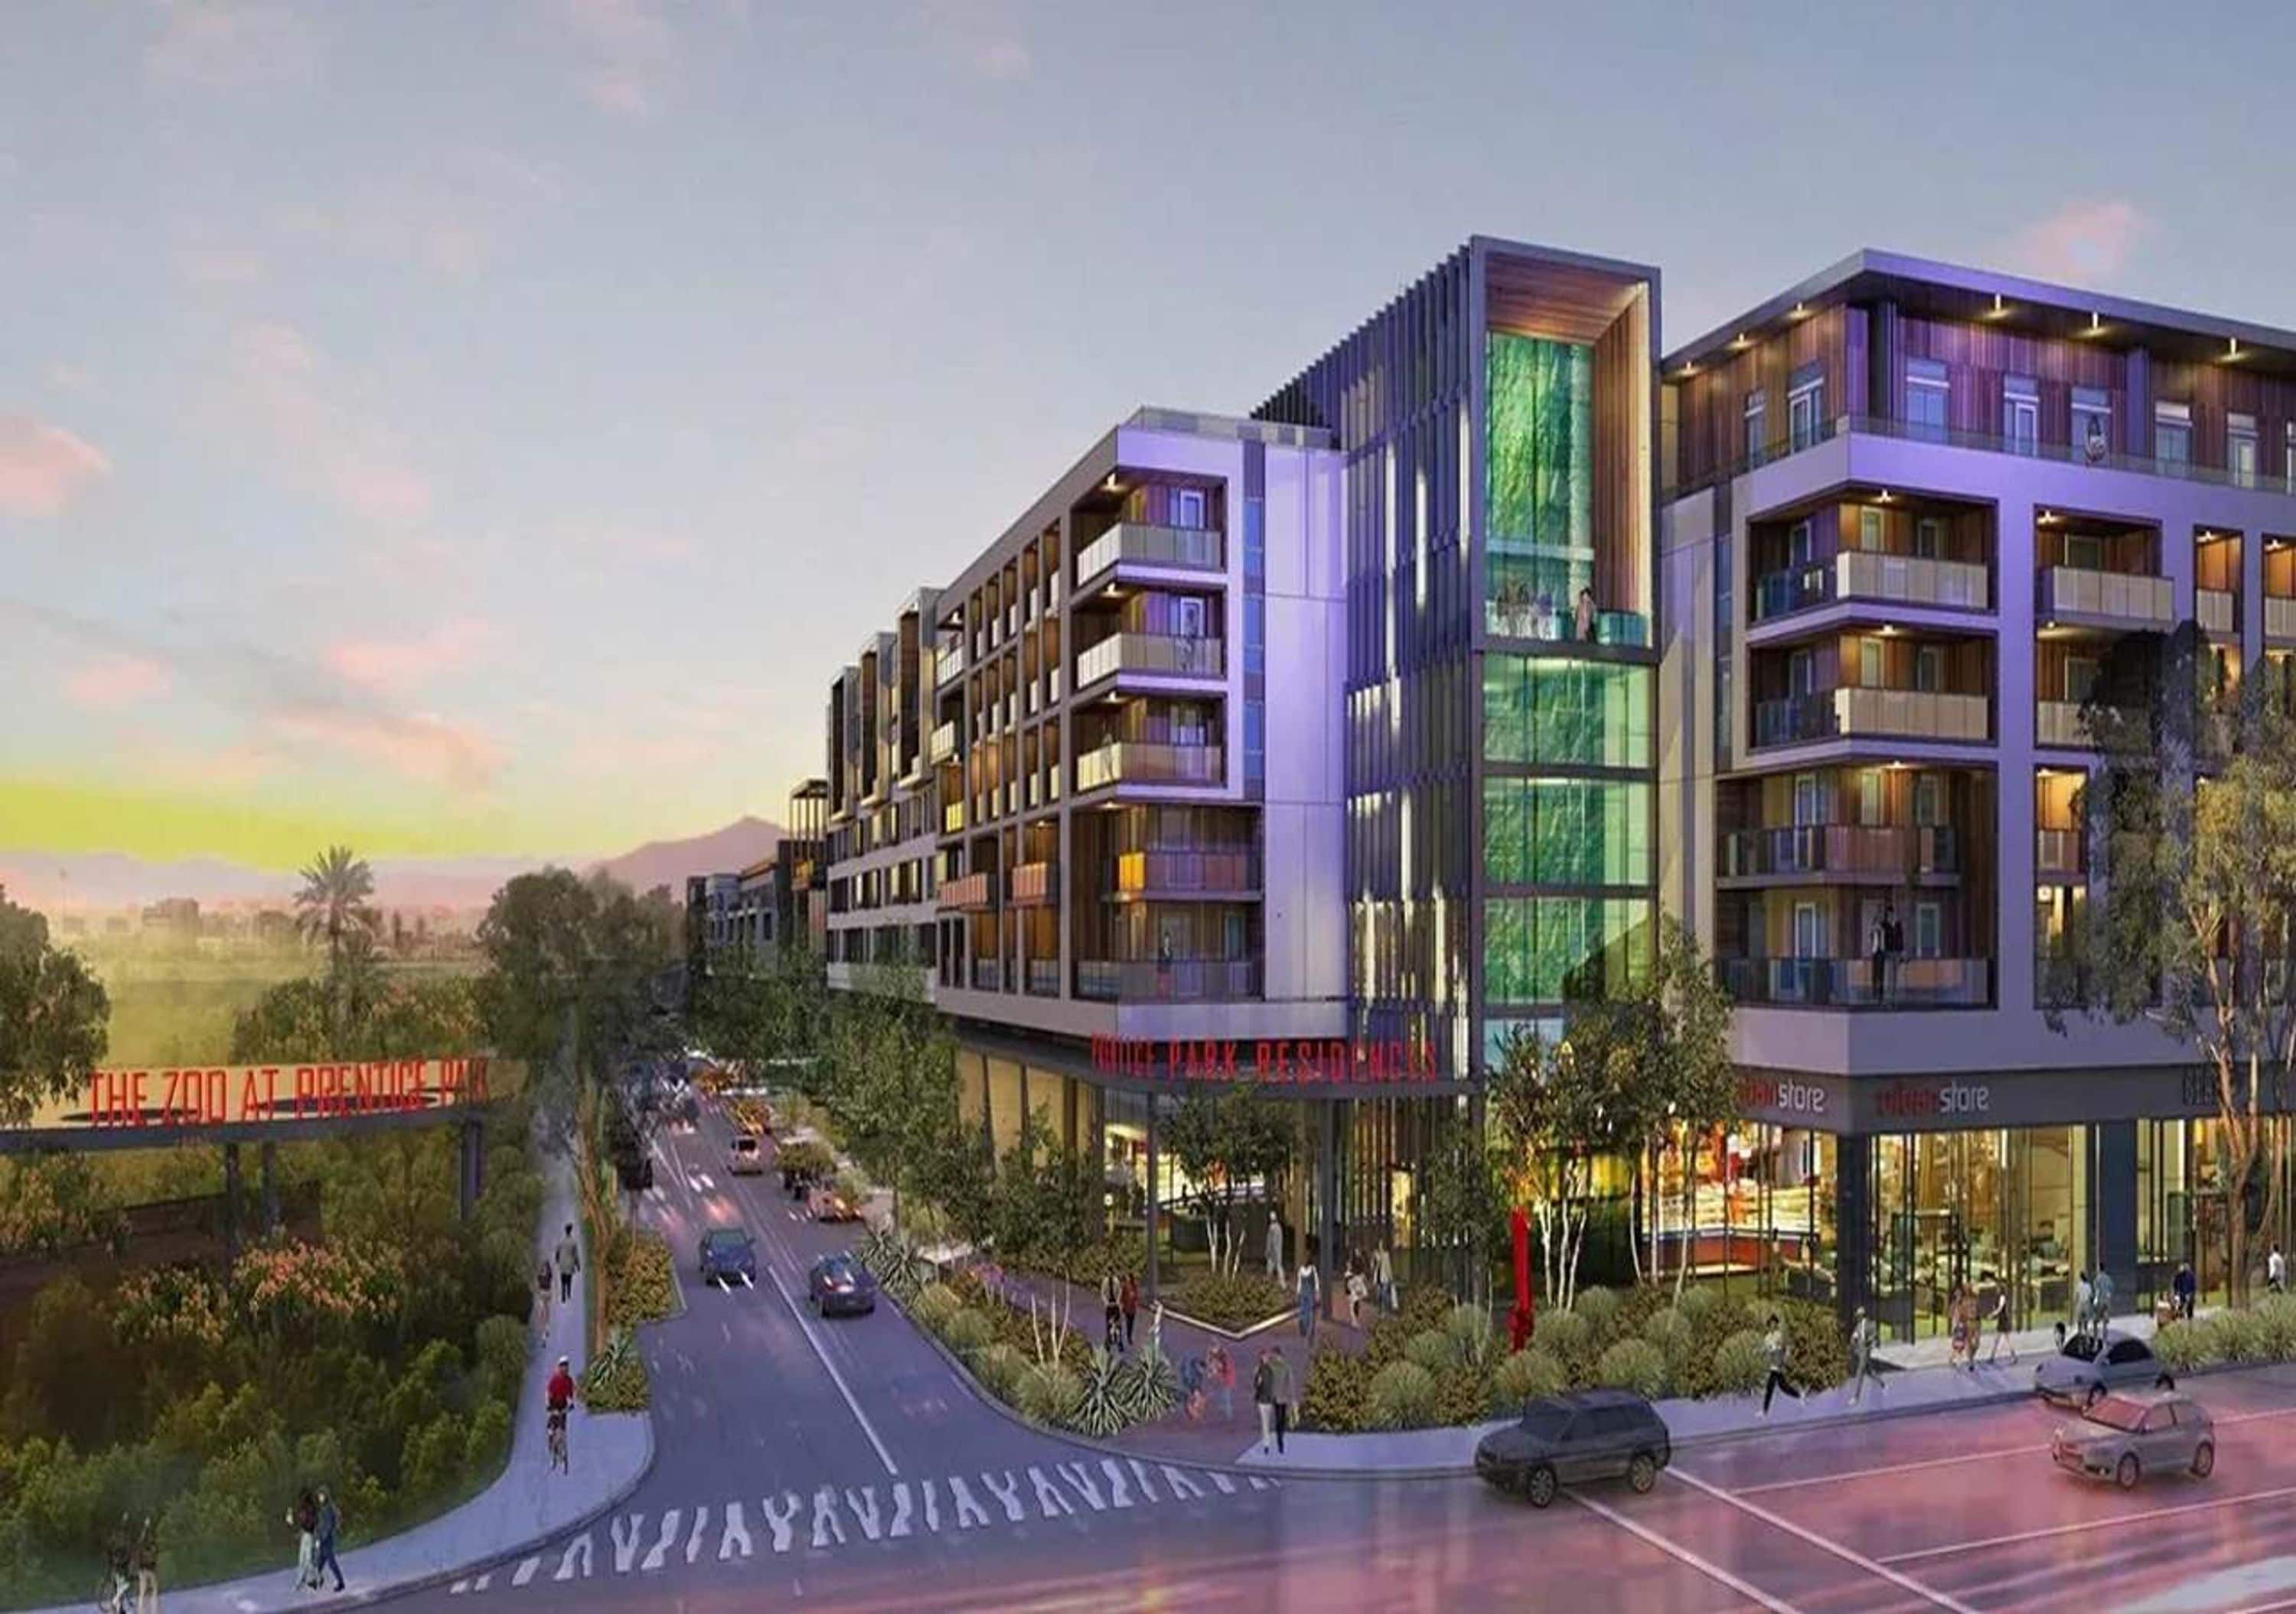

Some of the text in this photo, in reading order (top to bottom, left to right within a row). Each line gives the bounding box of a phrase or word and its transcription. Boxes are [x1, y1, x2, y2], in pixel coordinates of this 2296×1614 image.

[1168, 1035, 1237, 1081] PARK
[88, 1071, 148, 1129] THE
[162, 1068, 227, 1126] ZOO
[240, 1066, 279, 1121] AT
